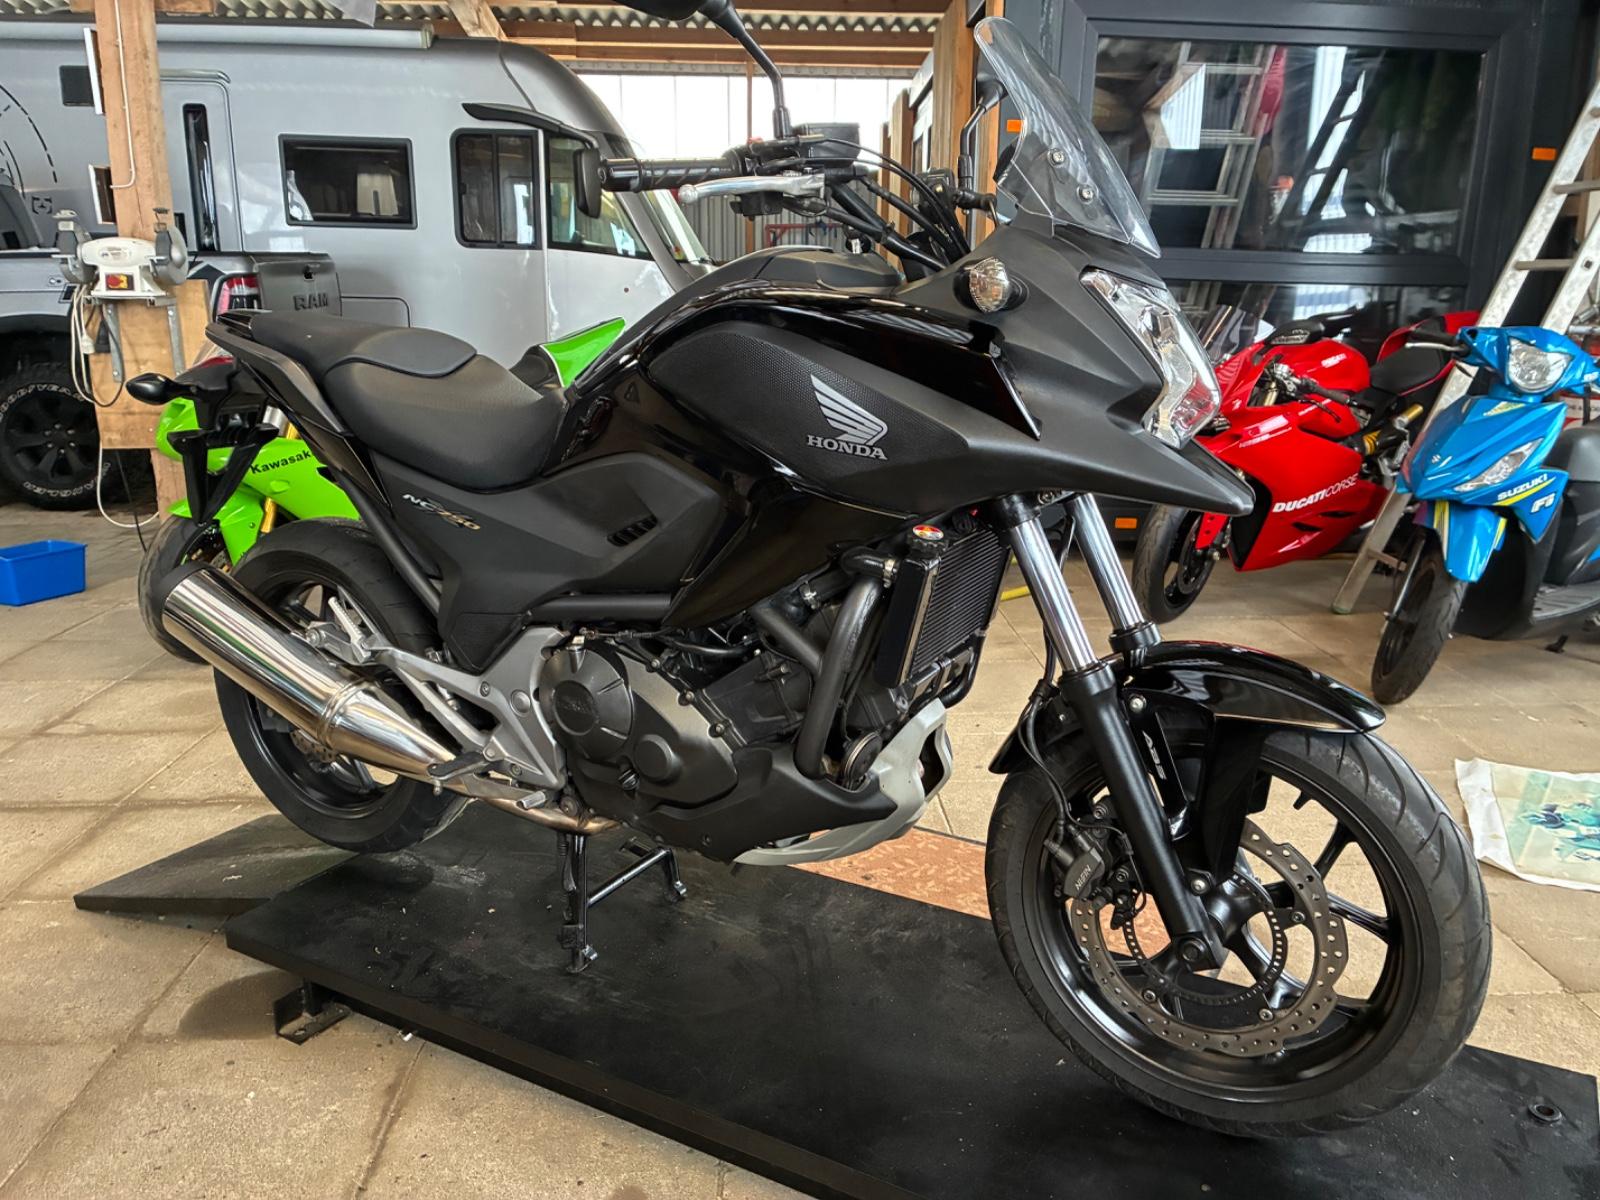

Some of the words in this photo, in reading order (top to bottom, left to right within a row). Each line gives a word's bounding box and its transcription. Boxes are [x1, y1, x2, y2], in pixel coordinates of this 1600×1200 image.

[293, 293, 328, 311] RAM
[807, 434, 888, 461] HONDA
[250, 450, 312, 475] Kawasak
[1497, 473, 1548, 501] SUZUKI
[1142, 730, 1168, 780] ABS
